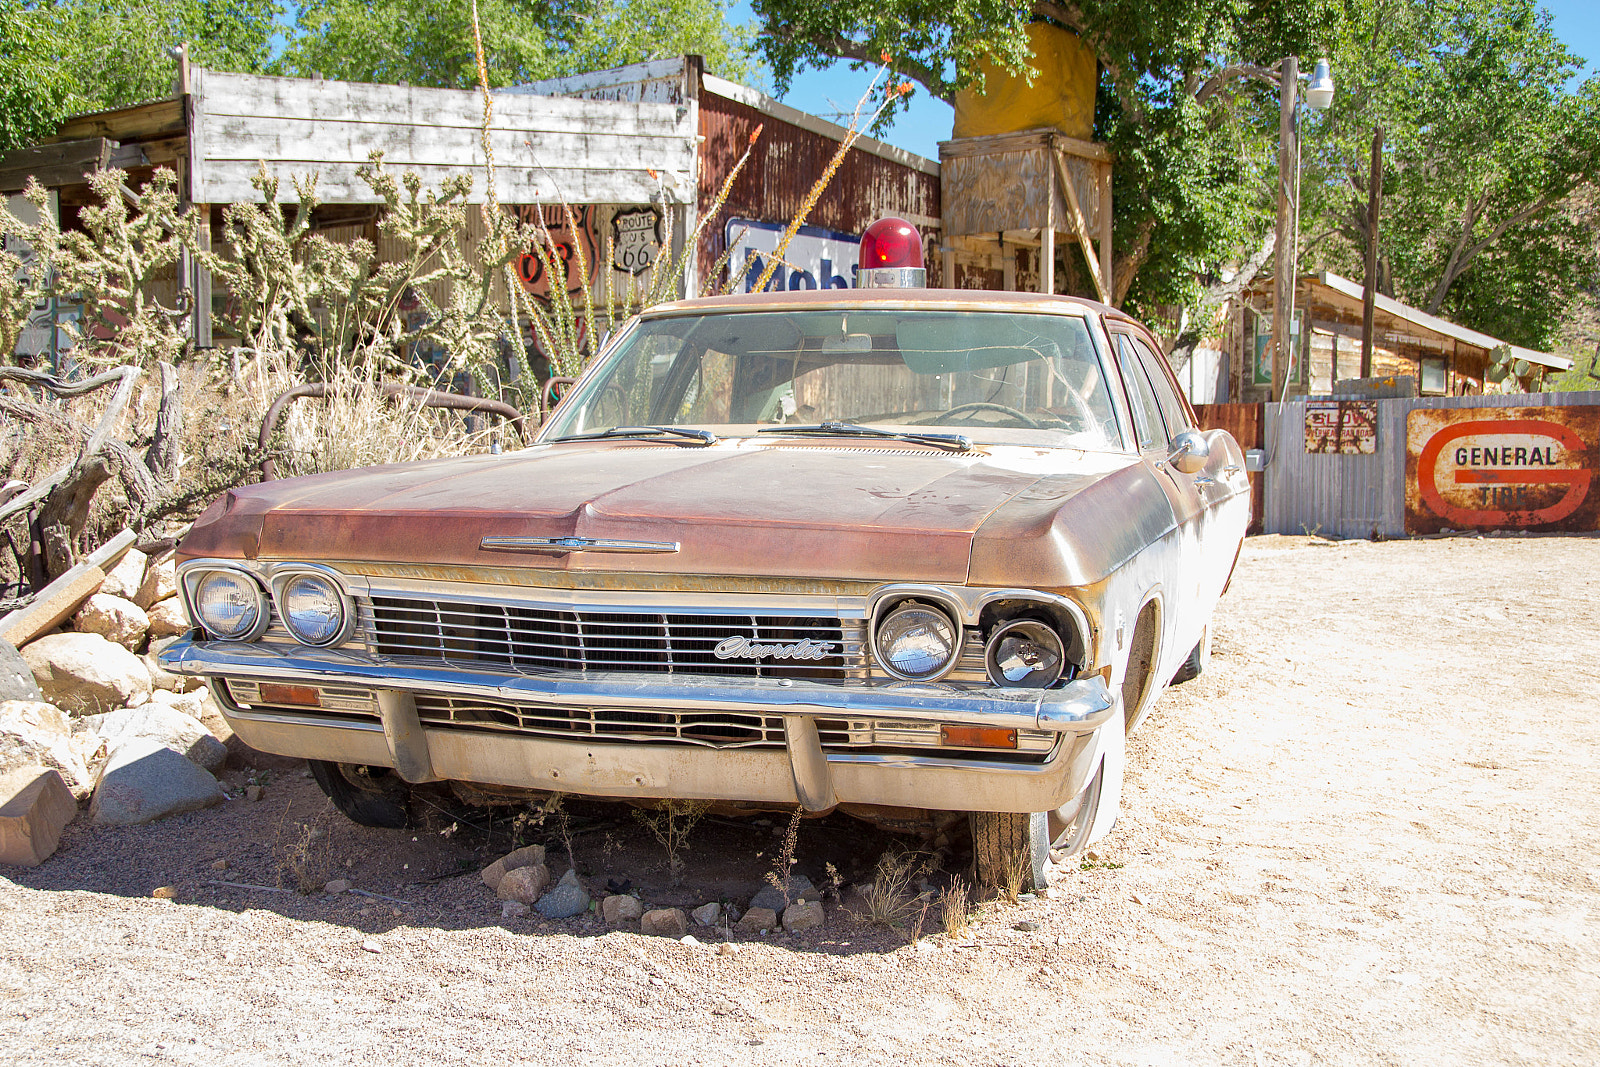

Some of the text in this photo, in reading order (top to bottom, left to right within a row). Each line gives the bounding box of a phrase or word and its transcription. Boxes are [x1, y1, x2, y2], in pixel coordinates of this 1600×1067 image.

[623, 215, 653, 229] ROUTE
[623, 243, 649, 267] 66
[1455, 446, 1557, 466] GENERAL
[1479, 486, 1527, 506] TIRE
[713, 635, 836, 661] Chevrolet
